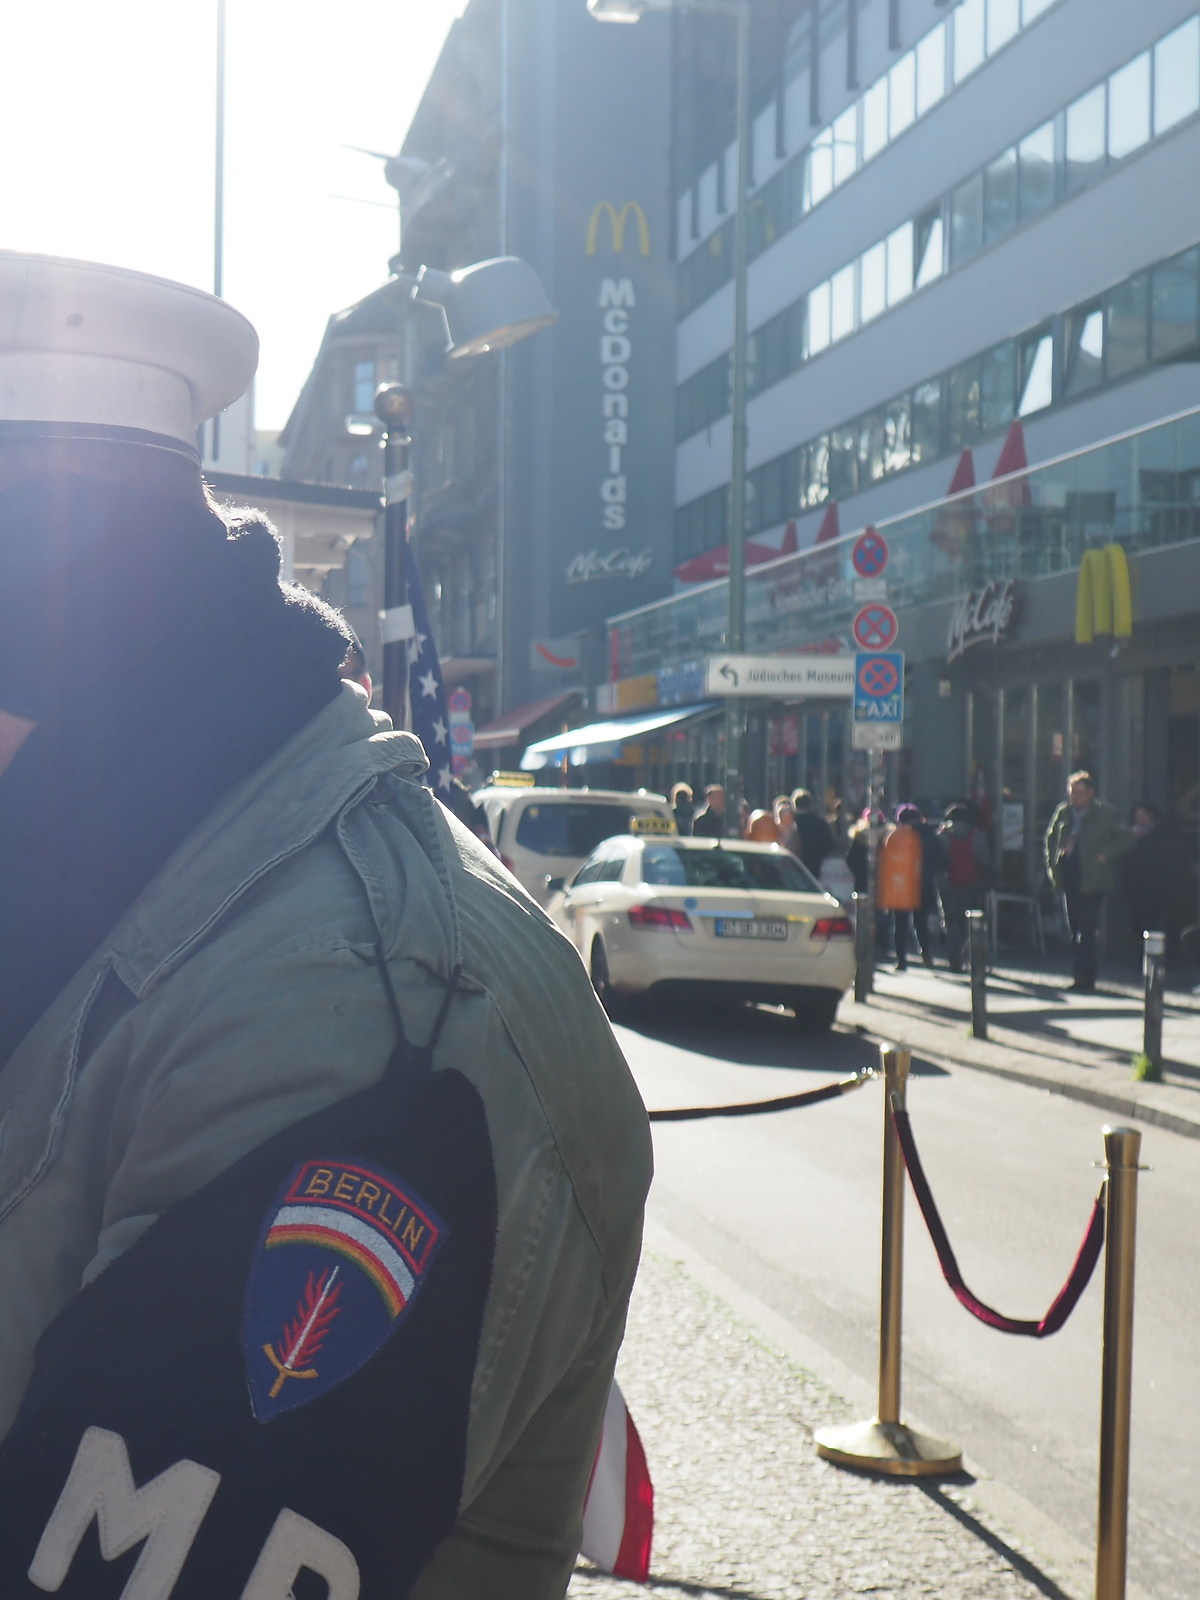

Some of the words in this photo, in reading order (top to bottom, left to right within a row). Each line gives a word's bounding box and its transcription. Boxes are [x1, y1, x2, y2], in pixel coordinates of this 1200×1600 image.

[599, 279, 636, 530] McDonalds
[747, 669, 802, 682] Jüdisches
[807, 670, 855, 682] Museum
[856, 701, 898, 717] TAXI
[305, 1168, 422, 1252] BERLIN
